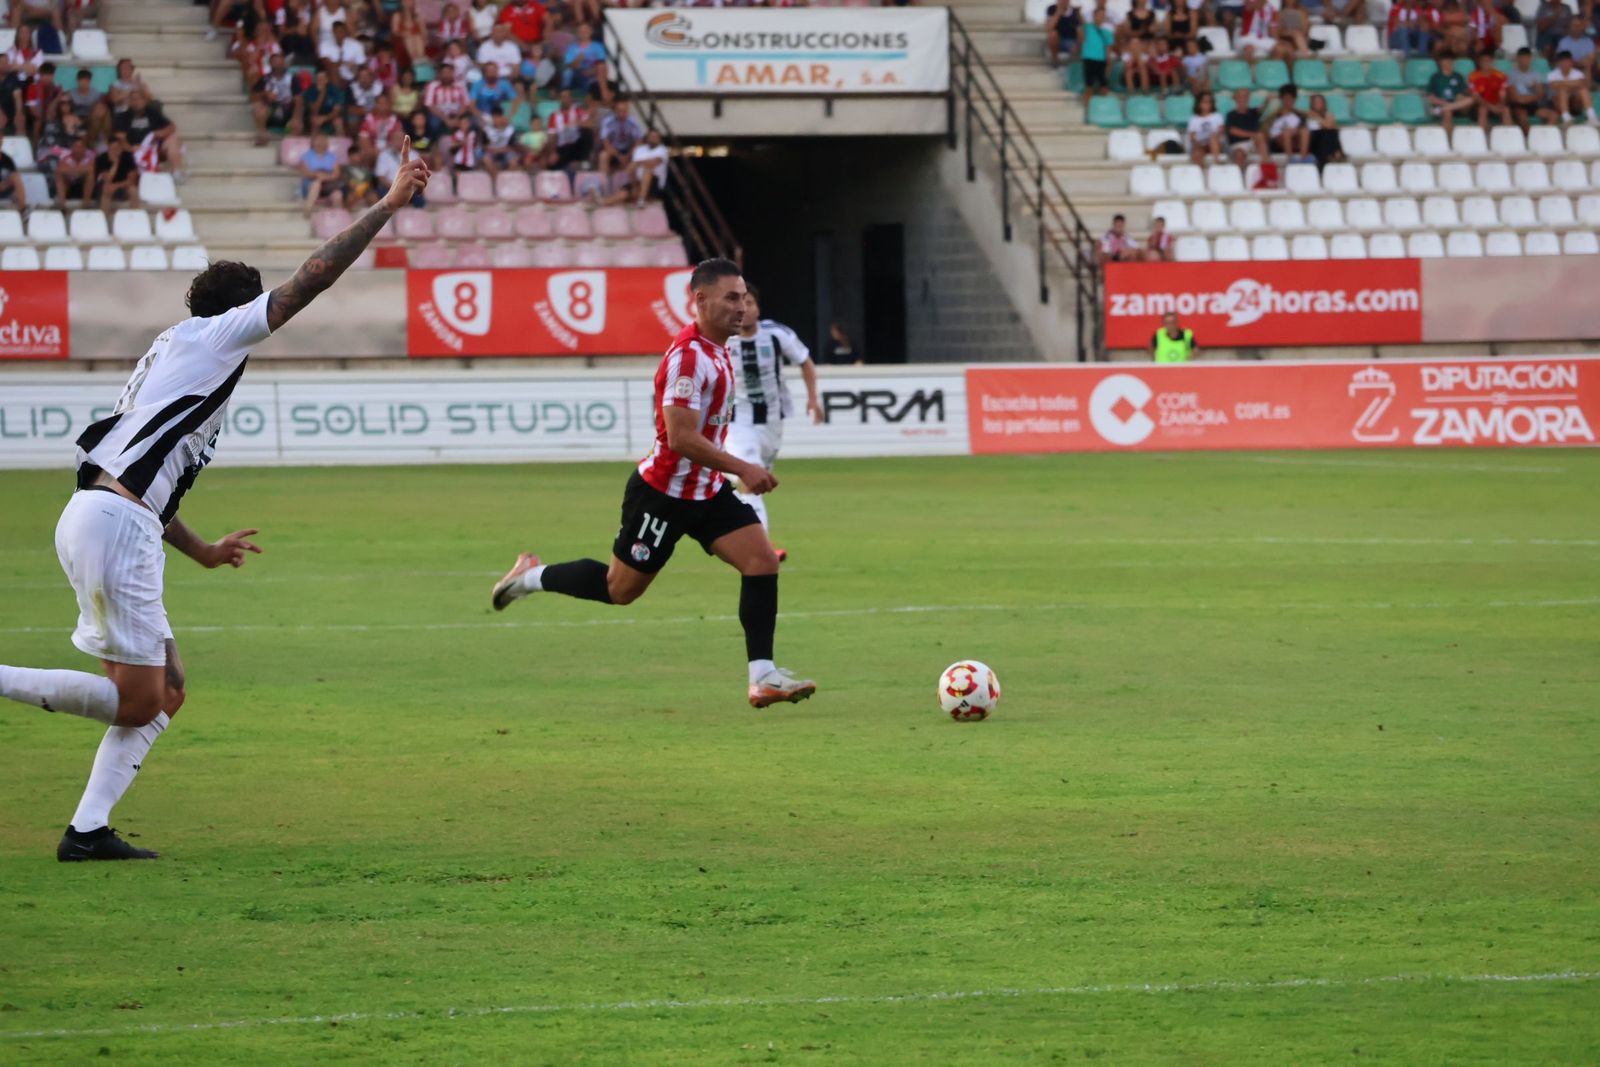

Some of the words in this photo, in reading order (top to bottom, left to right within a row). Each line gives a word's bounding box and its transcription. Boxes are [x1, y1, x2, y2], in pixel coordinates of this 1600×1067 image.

[454, 282, 478, 322] 8
[569, 281, 592, 321] 8
[291, 404, 430, 436] SOLID
[447, 401, 617, 434] STUDIO
[1160, 408, 1229, 426] ZAMORA
[1410, 405, 1595, 445] ZAMORA
[637, 512, 668, 548] 14
